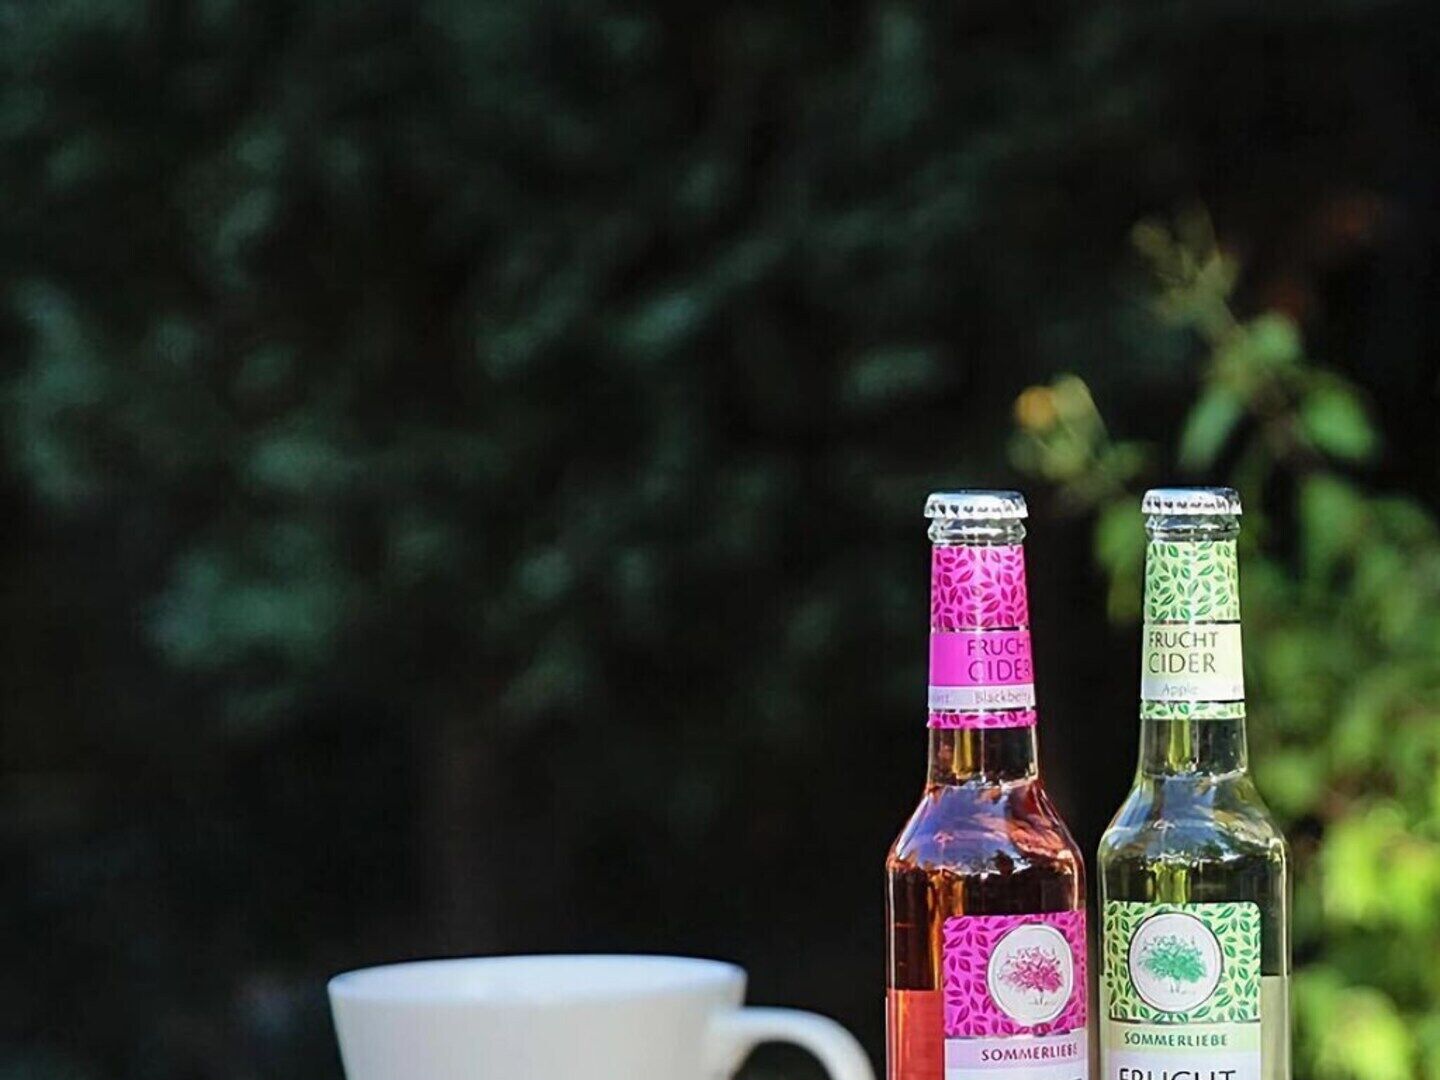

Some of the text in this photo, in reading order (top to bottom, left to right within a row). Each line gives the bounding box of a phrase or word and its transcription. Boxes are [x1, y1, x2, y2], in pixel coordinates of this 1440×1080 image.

[967, 638, 1028, 656] FRUCH
[1149, 631, 1218, 649] FRUCHT
[1148, 652, 1216, 674] CIDER
[1124, 1032, 1229, 1047] SOMMERLIEBE
